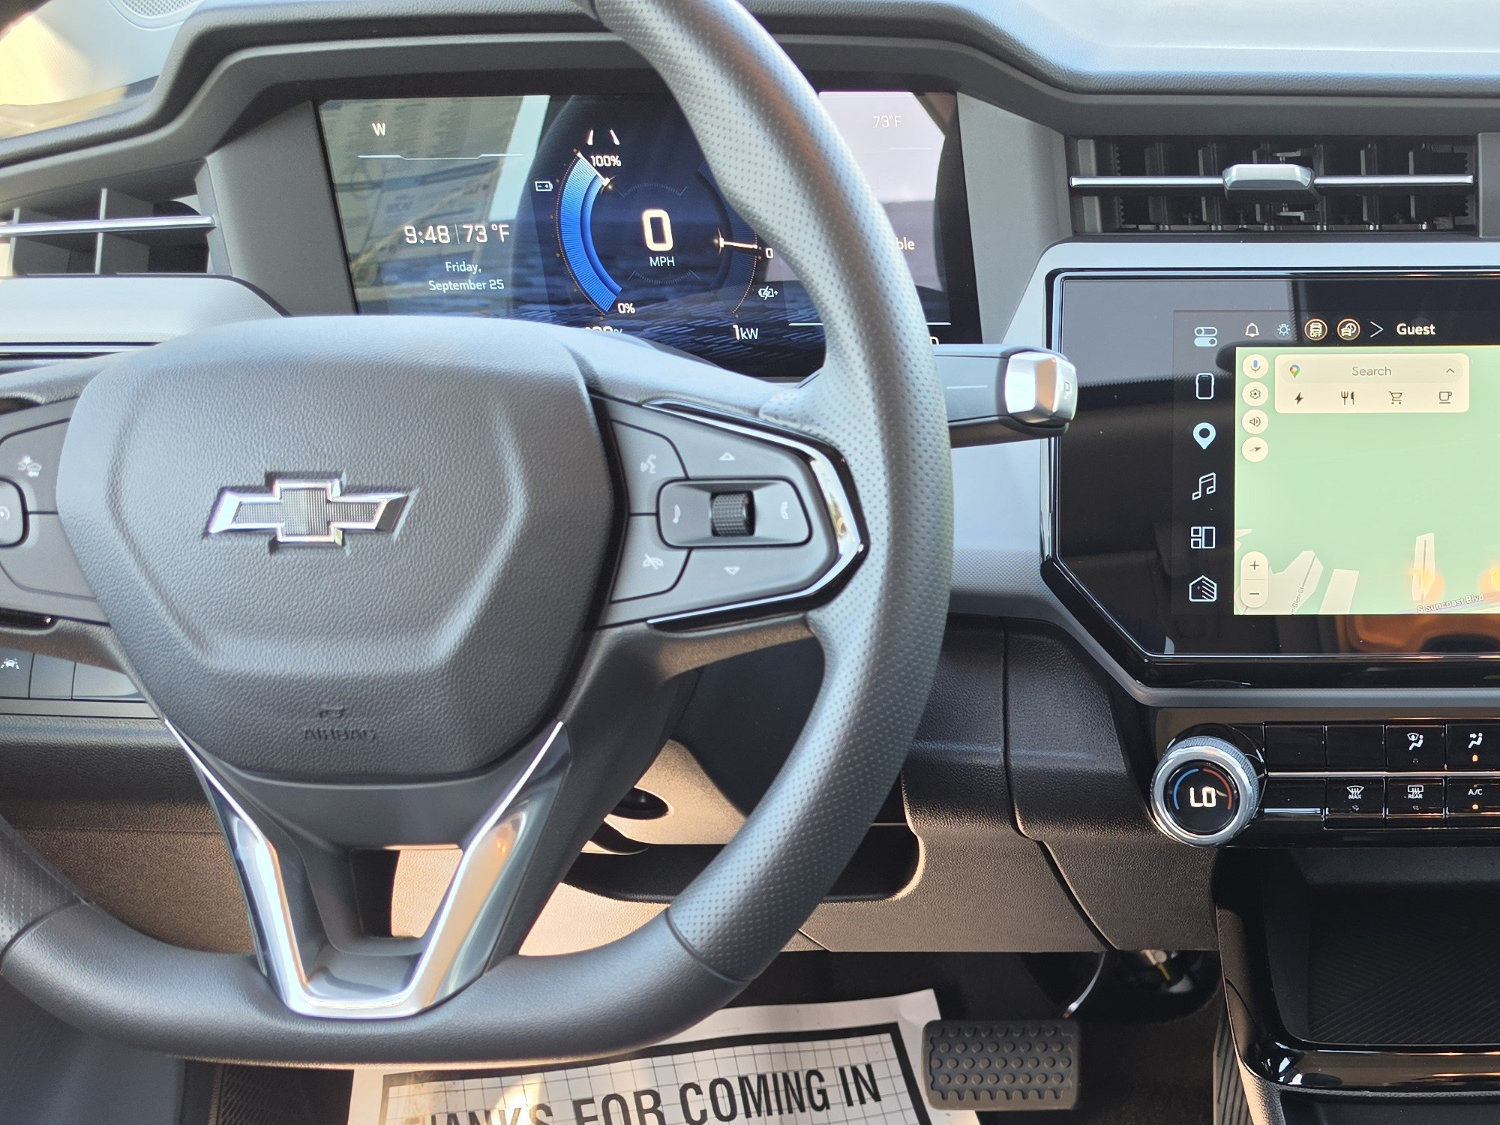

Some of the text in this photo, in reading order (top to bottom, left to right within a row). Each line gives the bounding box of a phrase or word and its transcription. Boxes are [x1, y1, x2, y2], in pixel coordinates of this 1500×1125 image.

[372, 123, 386, 136] W
[590, 155, 622, 167] 100%
[404, 225, 450, 244] 9:48
[642, 208, 674, 251] 0
[445, 261, 482, 274] Friday,
[649, 256, 675, 267] MPH
[428, 279, 504, 293] September 25
[617, 303, 636, 314] 0%
[1396, 323, 1436, 336] Guest
[1352, 366, 1392, 376] Search
[1426, 597, 1466, 613] Suncoast
[1466, 593, 1485, 605] Blvd
[1468, 788, 1483, 796] A/C
[838, 1062, 882, 1107] IN
